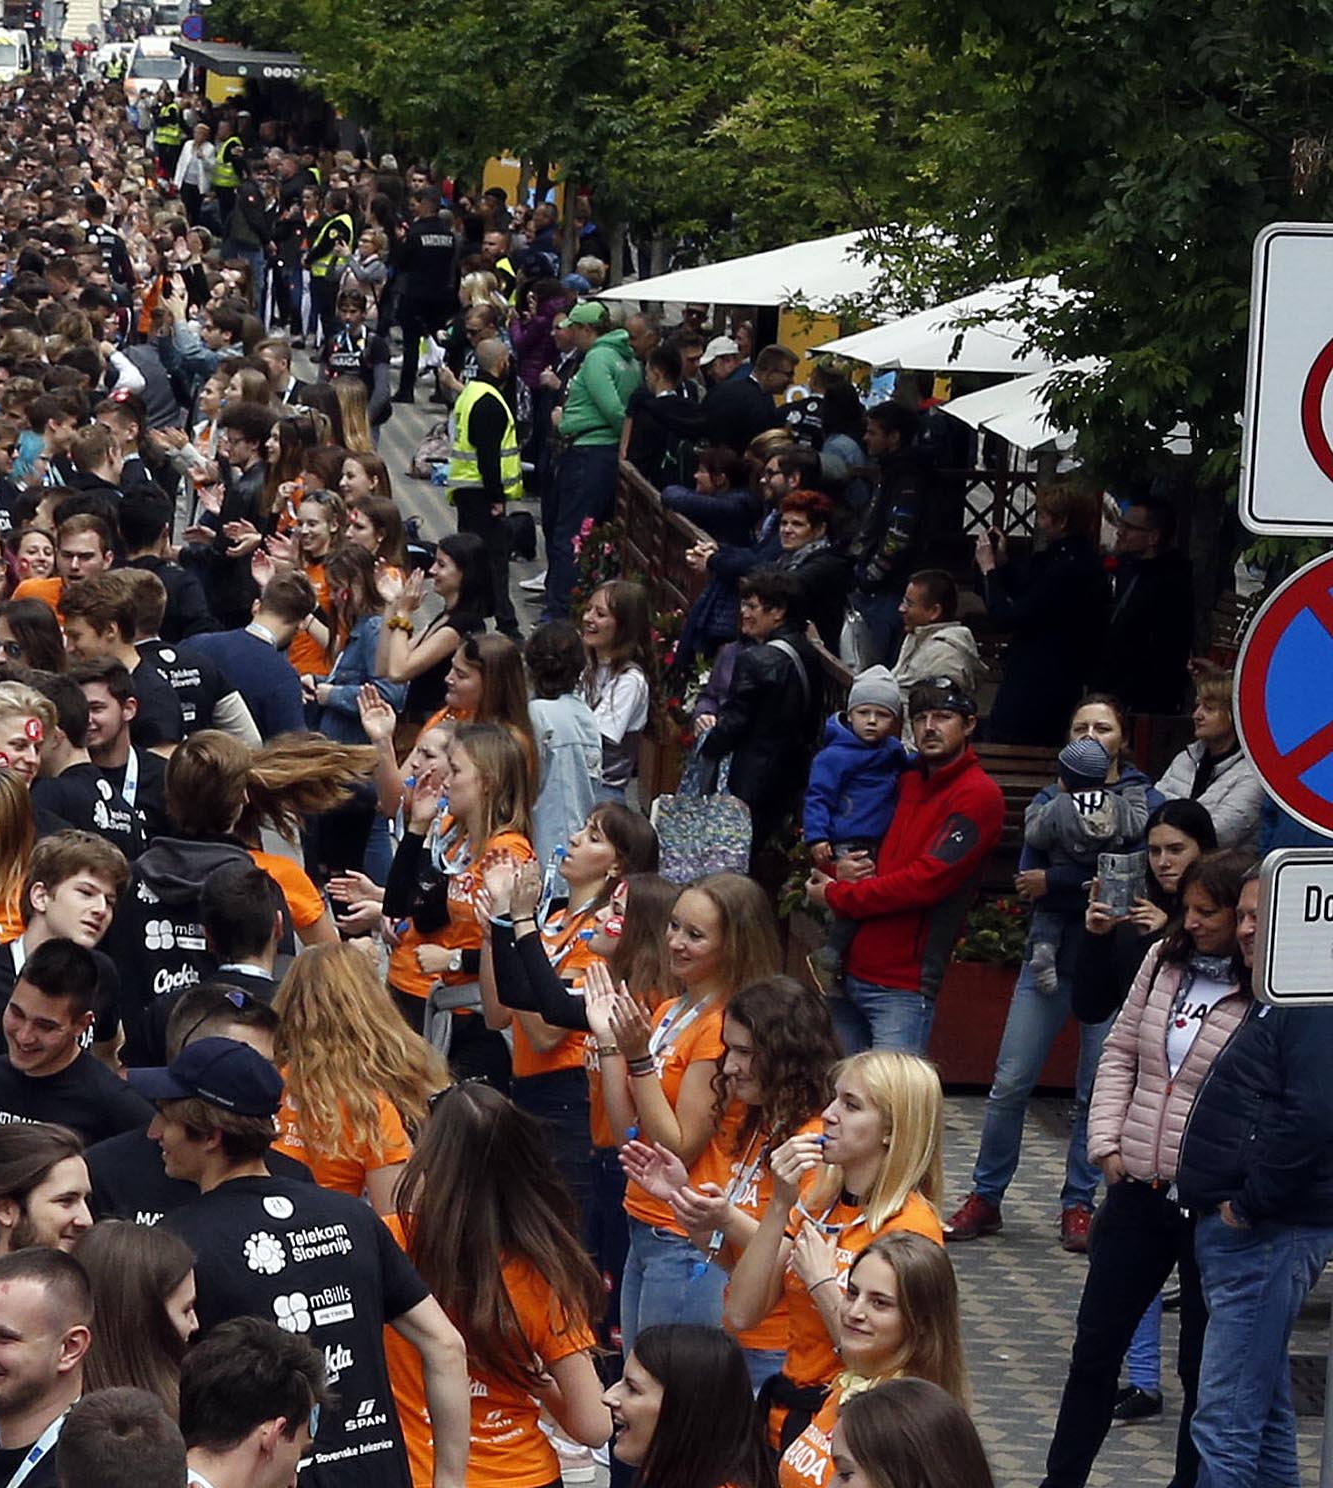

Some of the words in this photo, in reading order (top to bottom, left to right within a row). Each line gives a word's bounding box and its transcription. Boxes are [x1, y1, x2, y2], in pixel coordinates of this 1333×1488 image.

[286, 1223, 348, 1248] Telekom
[292, 1237, 353, 1263] Slovenije
[309, 1284, 351, 1308] mBills
[315, 1441, 359, 1464] Slovenske
